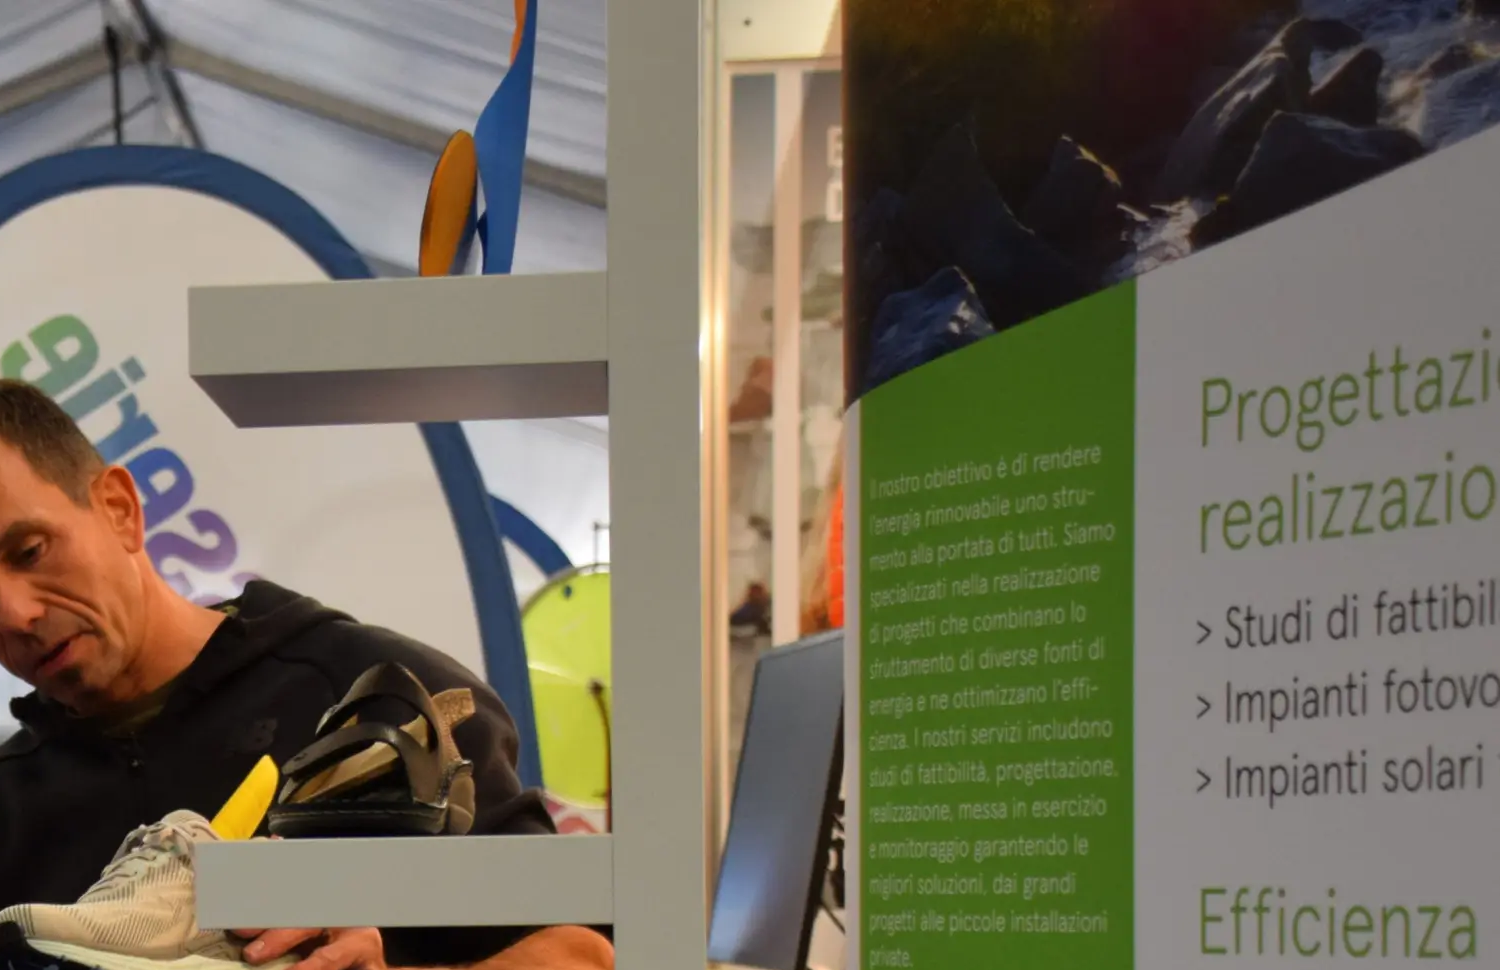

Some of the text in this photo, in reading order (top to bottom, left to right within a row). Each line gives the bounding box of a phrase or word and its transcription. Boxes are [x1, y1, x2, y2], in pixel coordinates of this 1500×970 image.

[879, 473, 920, 498] nostro
[924, 461, 991, 490] obiettivo
[1011, 452, 1028, 476] di
[1032, 444, 1101, 474] rendere
[925, 494, 1010, 528] rinnovabile
[1015, 494, 1048, 515] uno
[869, 548, 907, 572] mento
[910, 542, 934, 566] alla
[938, 535, 995, 569] portata
[998, 529, 1014, 555] di
[1063, 522, 1116, 546] Siamo
[870, 563, 1101, 611] specializzati nella realizzazione
[869, 599, 1087, 646] di progetti che combinano lo
[1224, 578, 1496, 650] Studi di fattibil
[959, 648, 974, 671] di
[979, 645, 1039, 670] diverse
[1043, 638, 1083, 664] fonti
[1088, 635, 1106, 660] di
[869, 692, 913, 719] energia
[917, 694, 926, 712] e
[930, 693, 949, 711] ne
[952, 684, 1048, 708] ottimizzano
[1225, 670, 1367, 734] Impianti
[922, 723, 966, 748] nostri
[971, 720, 1022, 745] servizi
[1027, 716, 1114, 741] includono
[869, 766, 898, 788] studi
[900, 763, 914, 786] di
[1225, 743, 1484, 810] Impianti solari
[958, 802, 1008, 820] messa
[1011, 796, 1027, 819] in
[1031, 793, 1108, 818] esercizio
[879, 835, 969, 863] monitoraggio
[973, 832, 1068, 863] garantendo
[1072, 832, 1089, 856] le
[869, 872, 913, 901] migliori
[992, 871, 1018, 895] dai
[1023, 870, 1077, 901] grandi
[869, 908, 1108, 938] progetti alle piccole installazioni
[1200, 886, 1477, 960] Efficienza
